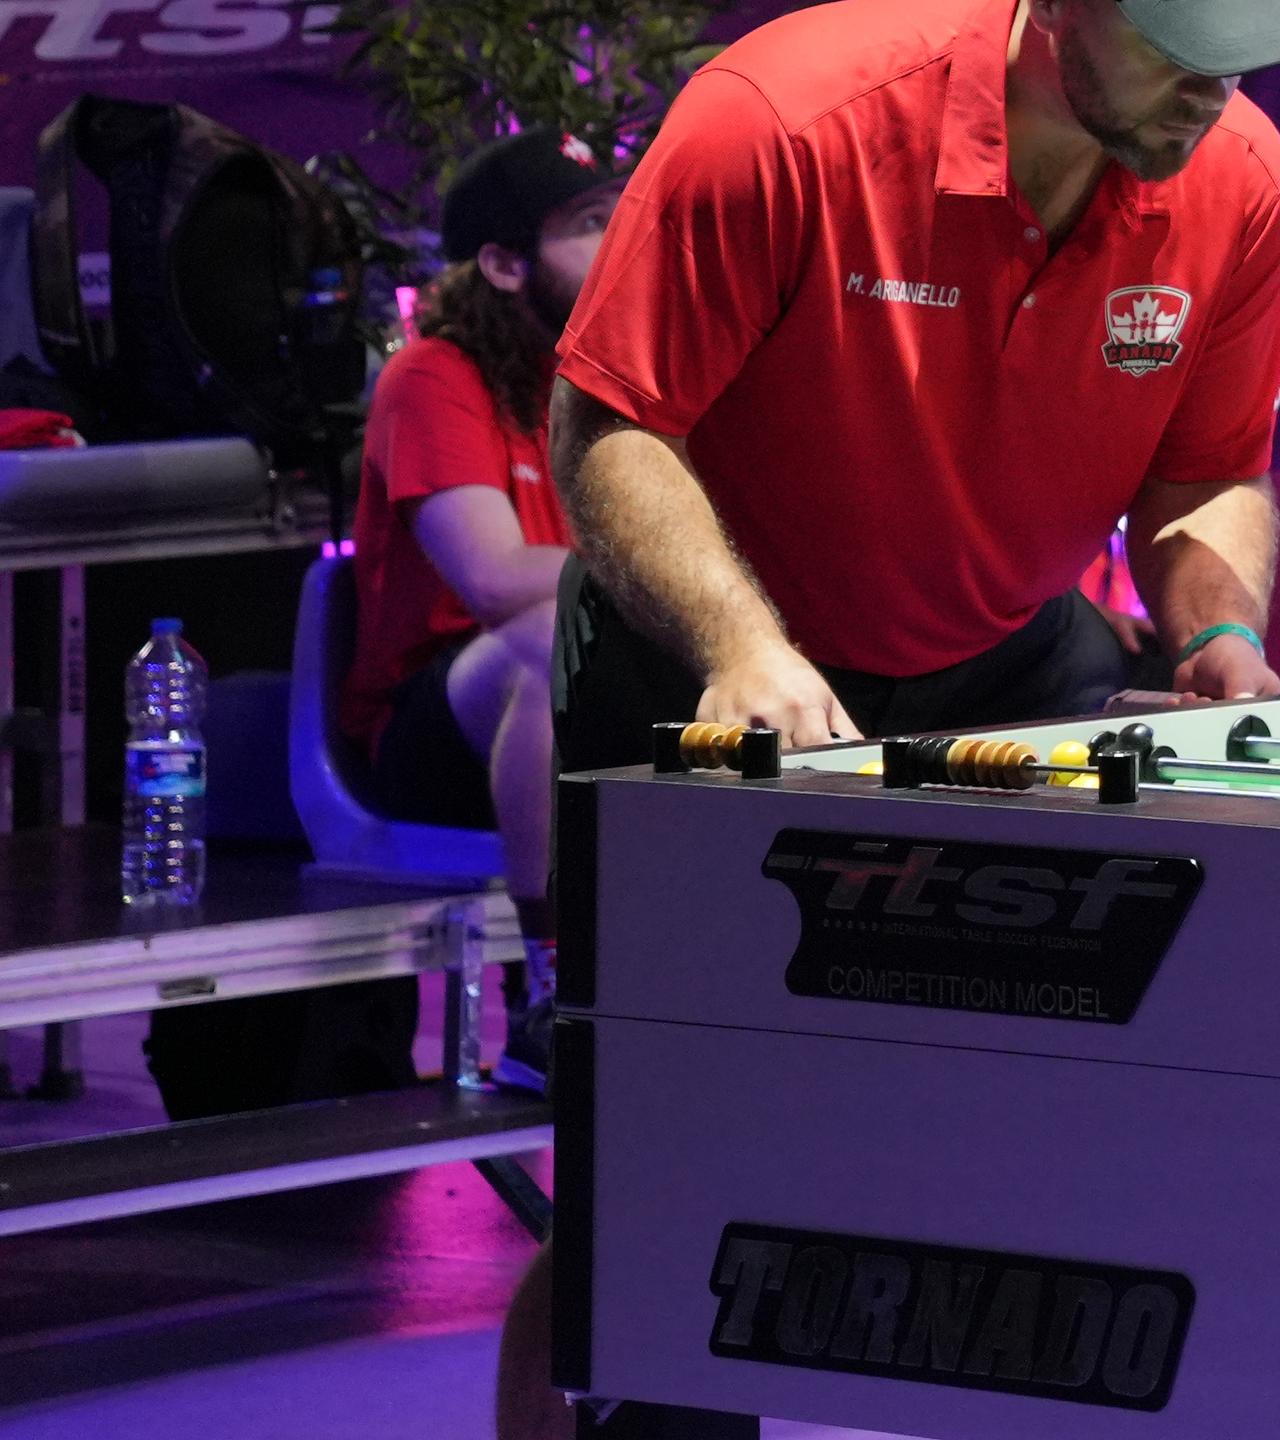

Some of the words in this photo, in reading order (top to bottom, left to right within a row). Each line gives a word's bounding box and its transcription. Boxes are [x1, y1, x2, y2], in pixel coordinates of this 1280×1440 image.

[845, 271, 865, 294] M.
[869, 278, 961, 309] ARGANELLO
[827, 964, 1008, 1011] COMPETITION
[1014, 980, 1110, 1020] MODEL
[716, 1237, 1180, 1399] TORNADO
